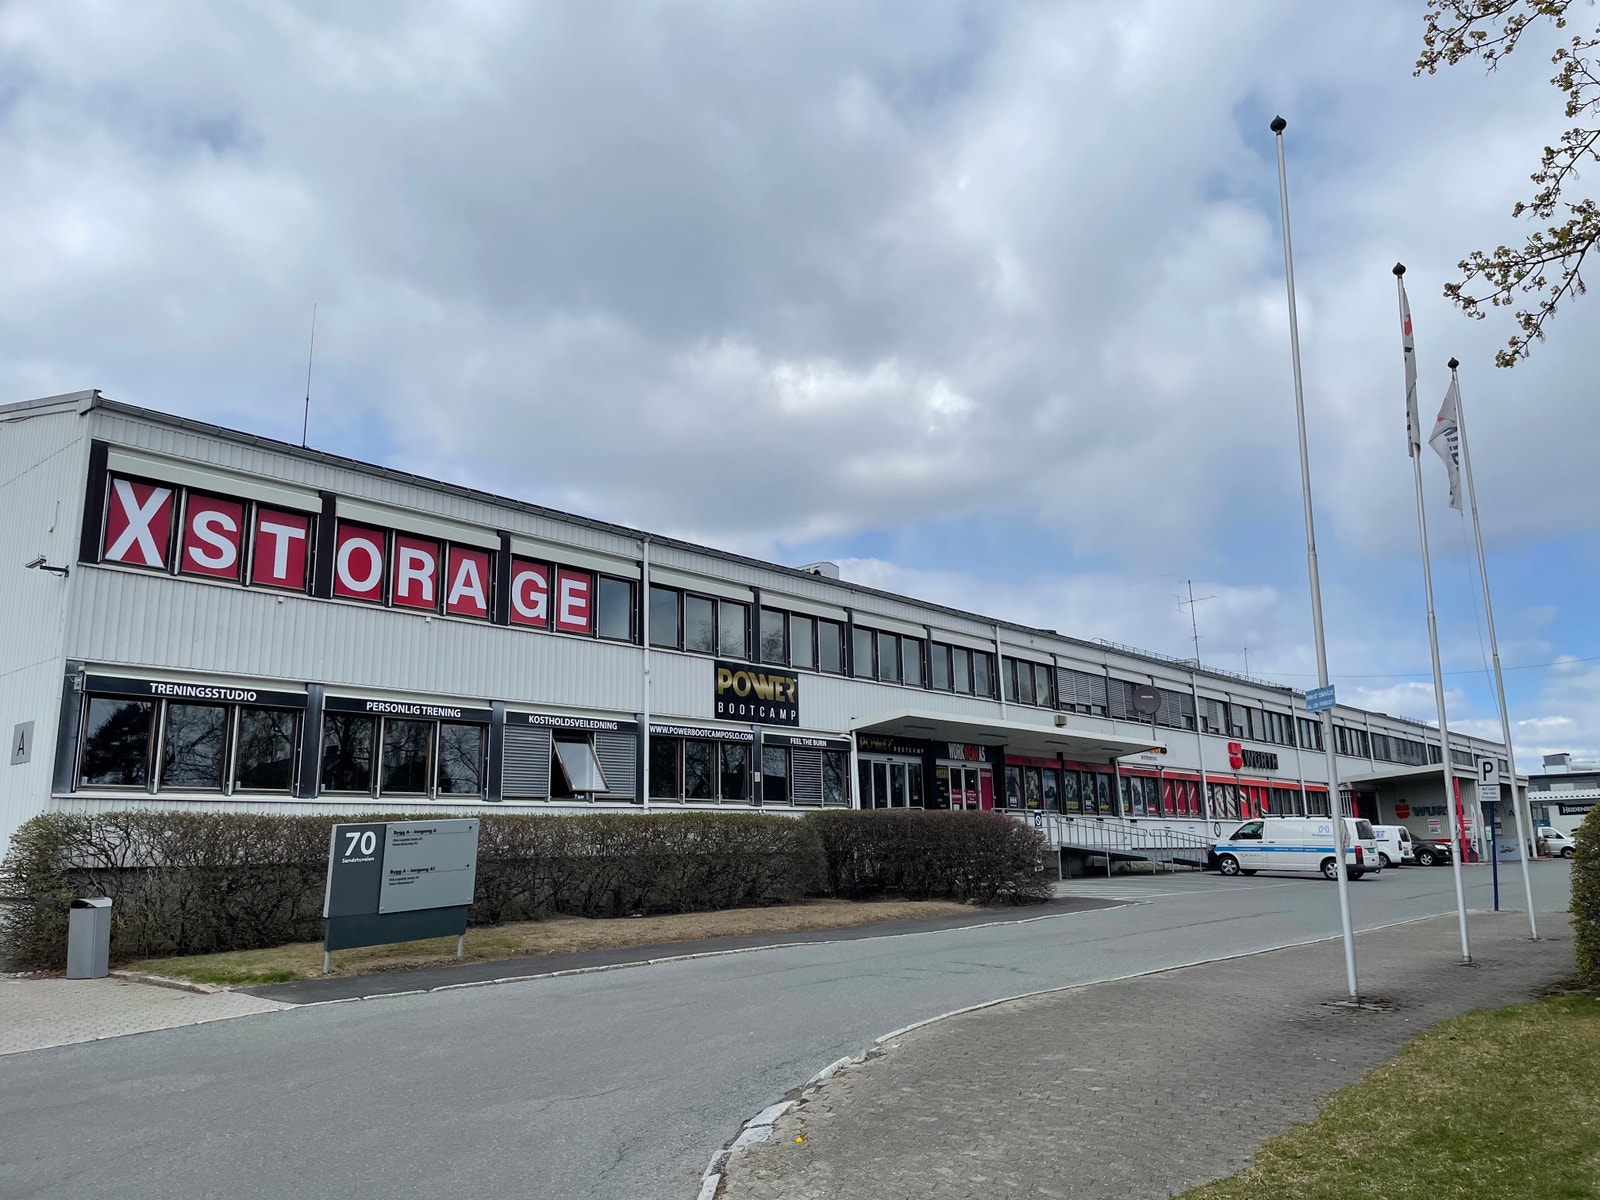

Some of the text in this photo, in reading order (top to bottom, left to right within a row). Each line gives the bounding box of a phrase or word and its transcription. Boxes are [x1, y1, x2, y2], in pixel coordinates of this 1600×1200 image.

[105, 479, 588, 625] XSTORAGE
[149, 682, 257, 702] TRENINGSSTUDIO
[717, 667, 795, 703] POWER
[366, 701, 461, 718] PERSONLIG TRENING
[717, 701, 796, 720] BOOTCAMP
[528, 714, 618, 730] KOSTHOLDSVEILEDNING
[649, 724, 754, 741] WWW.POWERBOOTCAMPOSLO.COM
[790, 737, 802, 745] FEEL
[813, 739, 827, 747] BURN
[17, 730, 25, 756] A
[979, 745, 986, 761] AS
[1482, 761, 1494, 781] P
[344, 831, 377, 856] 70
